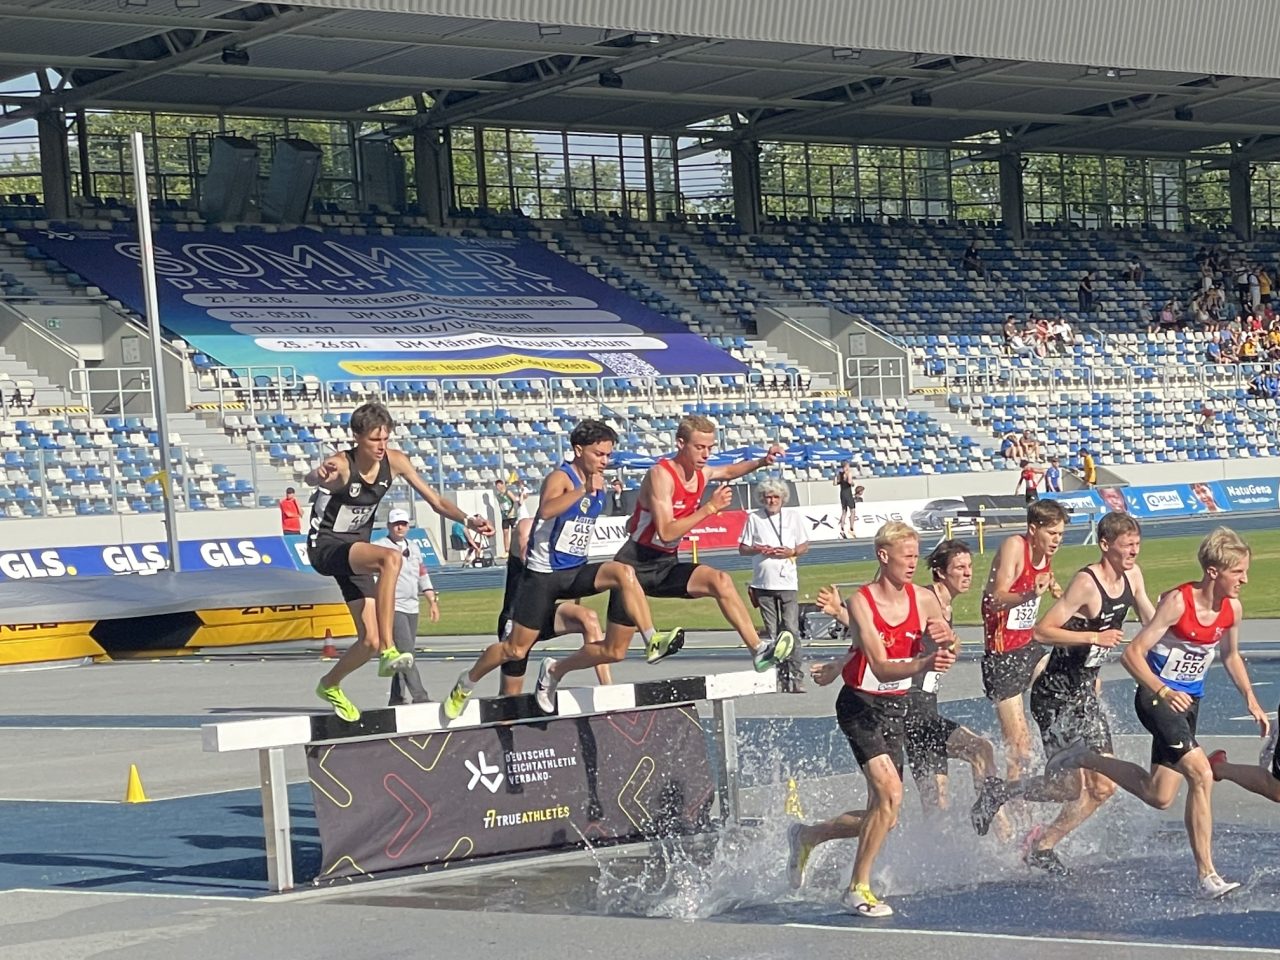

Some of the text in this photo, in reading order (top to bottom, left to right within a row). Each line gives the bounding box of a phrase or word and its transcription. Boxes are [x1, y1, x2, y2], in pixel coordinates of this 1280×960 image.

[113, 240, 553, 281] SOMMER
[165, 275, 567, 294] DER LEICHTATHLETIK
[497, 297, 573, 308] Ratingen
[348, 310, 383, 320] DM
[465, 310, 534, 321] Bochum
[372, 325, 405, 334] DM
[484, 324, 557, 335] Bochum
[395, 339, 429, 349] DM
[562, 338, 632, 350] Bochum
[1226, 483, 1273, 498] NatuGena
[1069, 497, 1094, 510] PLAN
[1157, 493, 1181, 507] PLAN
[573, 523, 591, 535] GLS
[199, 540, 272, 568] GLS.
[0, 550, 77, 580] GLS.
[1183, 650, 1206, 662] GLS
[1170, 659, 1206, 675] 1556
[505, 748, 556, 763] DEUTSCHER
[507, 756, 577, 774] LEICHTATHLETIK
[496, 806, 570, 827] TRUEATHLETES
